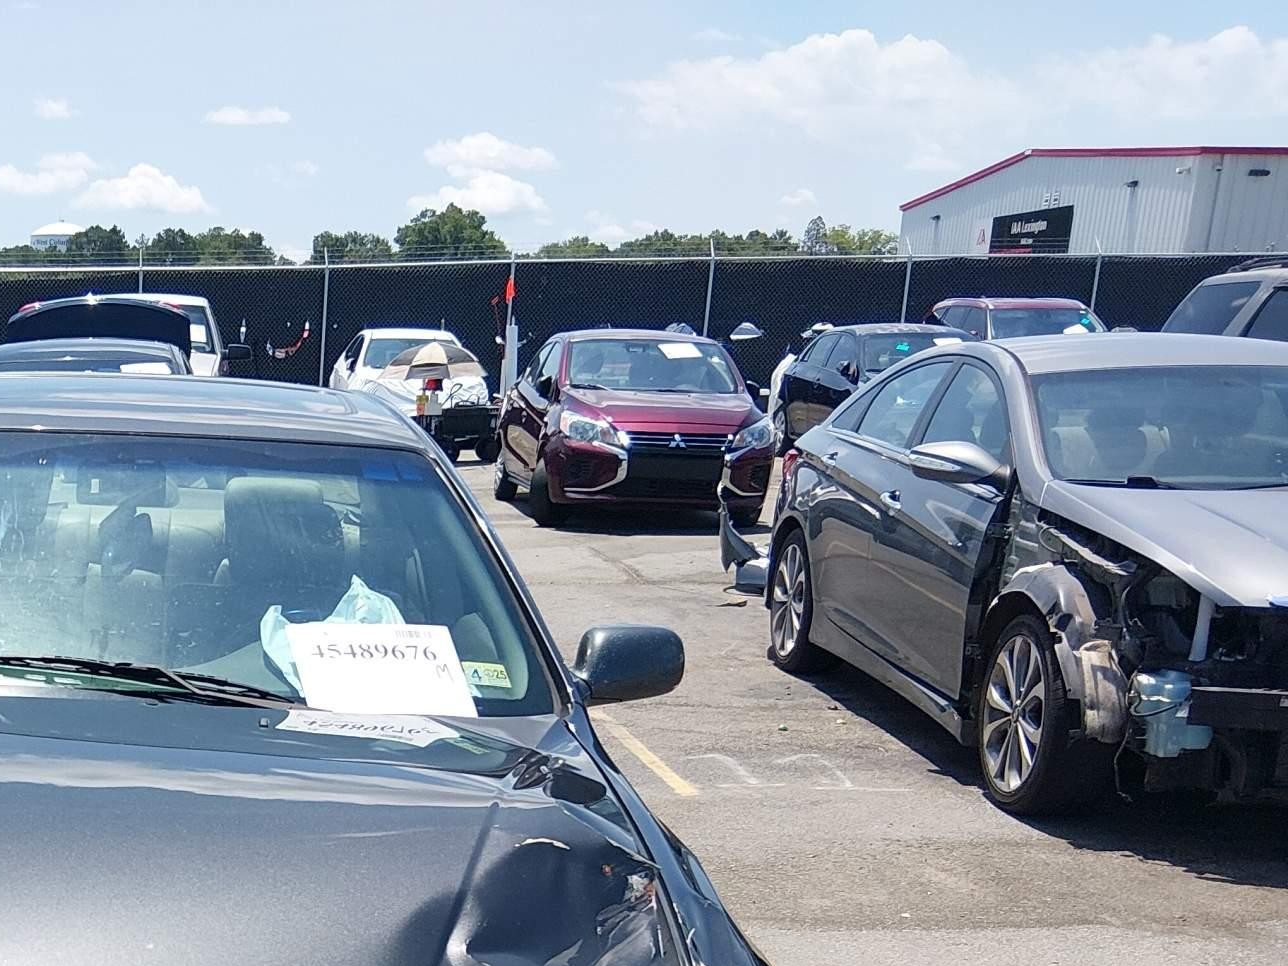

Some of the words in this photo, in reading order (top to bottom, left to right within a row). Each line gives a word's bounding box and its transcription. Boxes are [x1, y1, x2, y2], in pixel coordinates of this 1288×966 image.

[1010, 220, 1021, 234] IAA
[1021, 219, 1048, 234] Lexington
[312, 643, 438, 661] 45489676
[471, 667, 482, 681] 4
